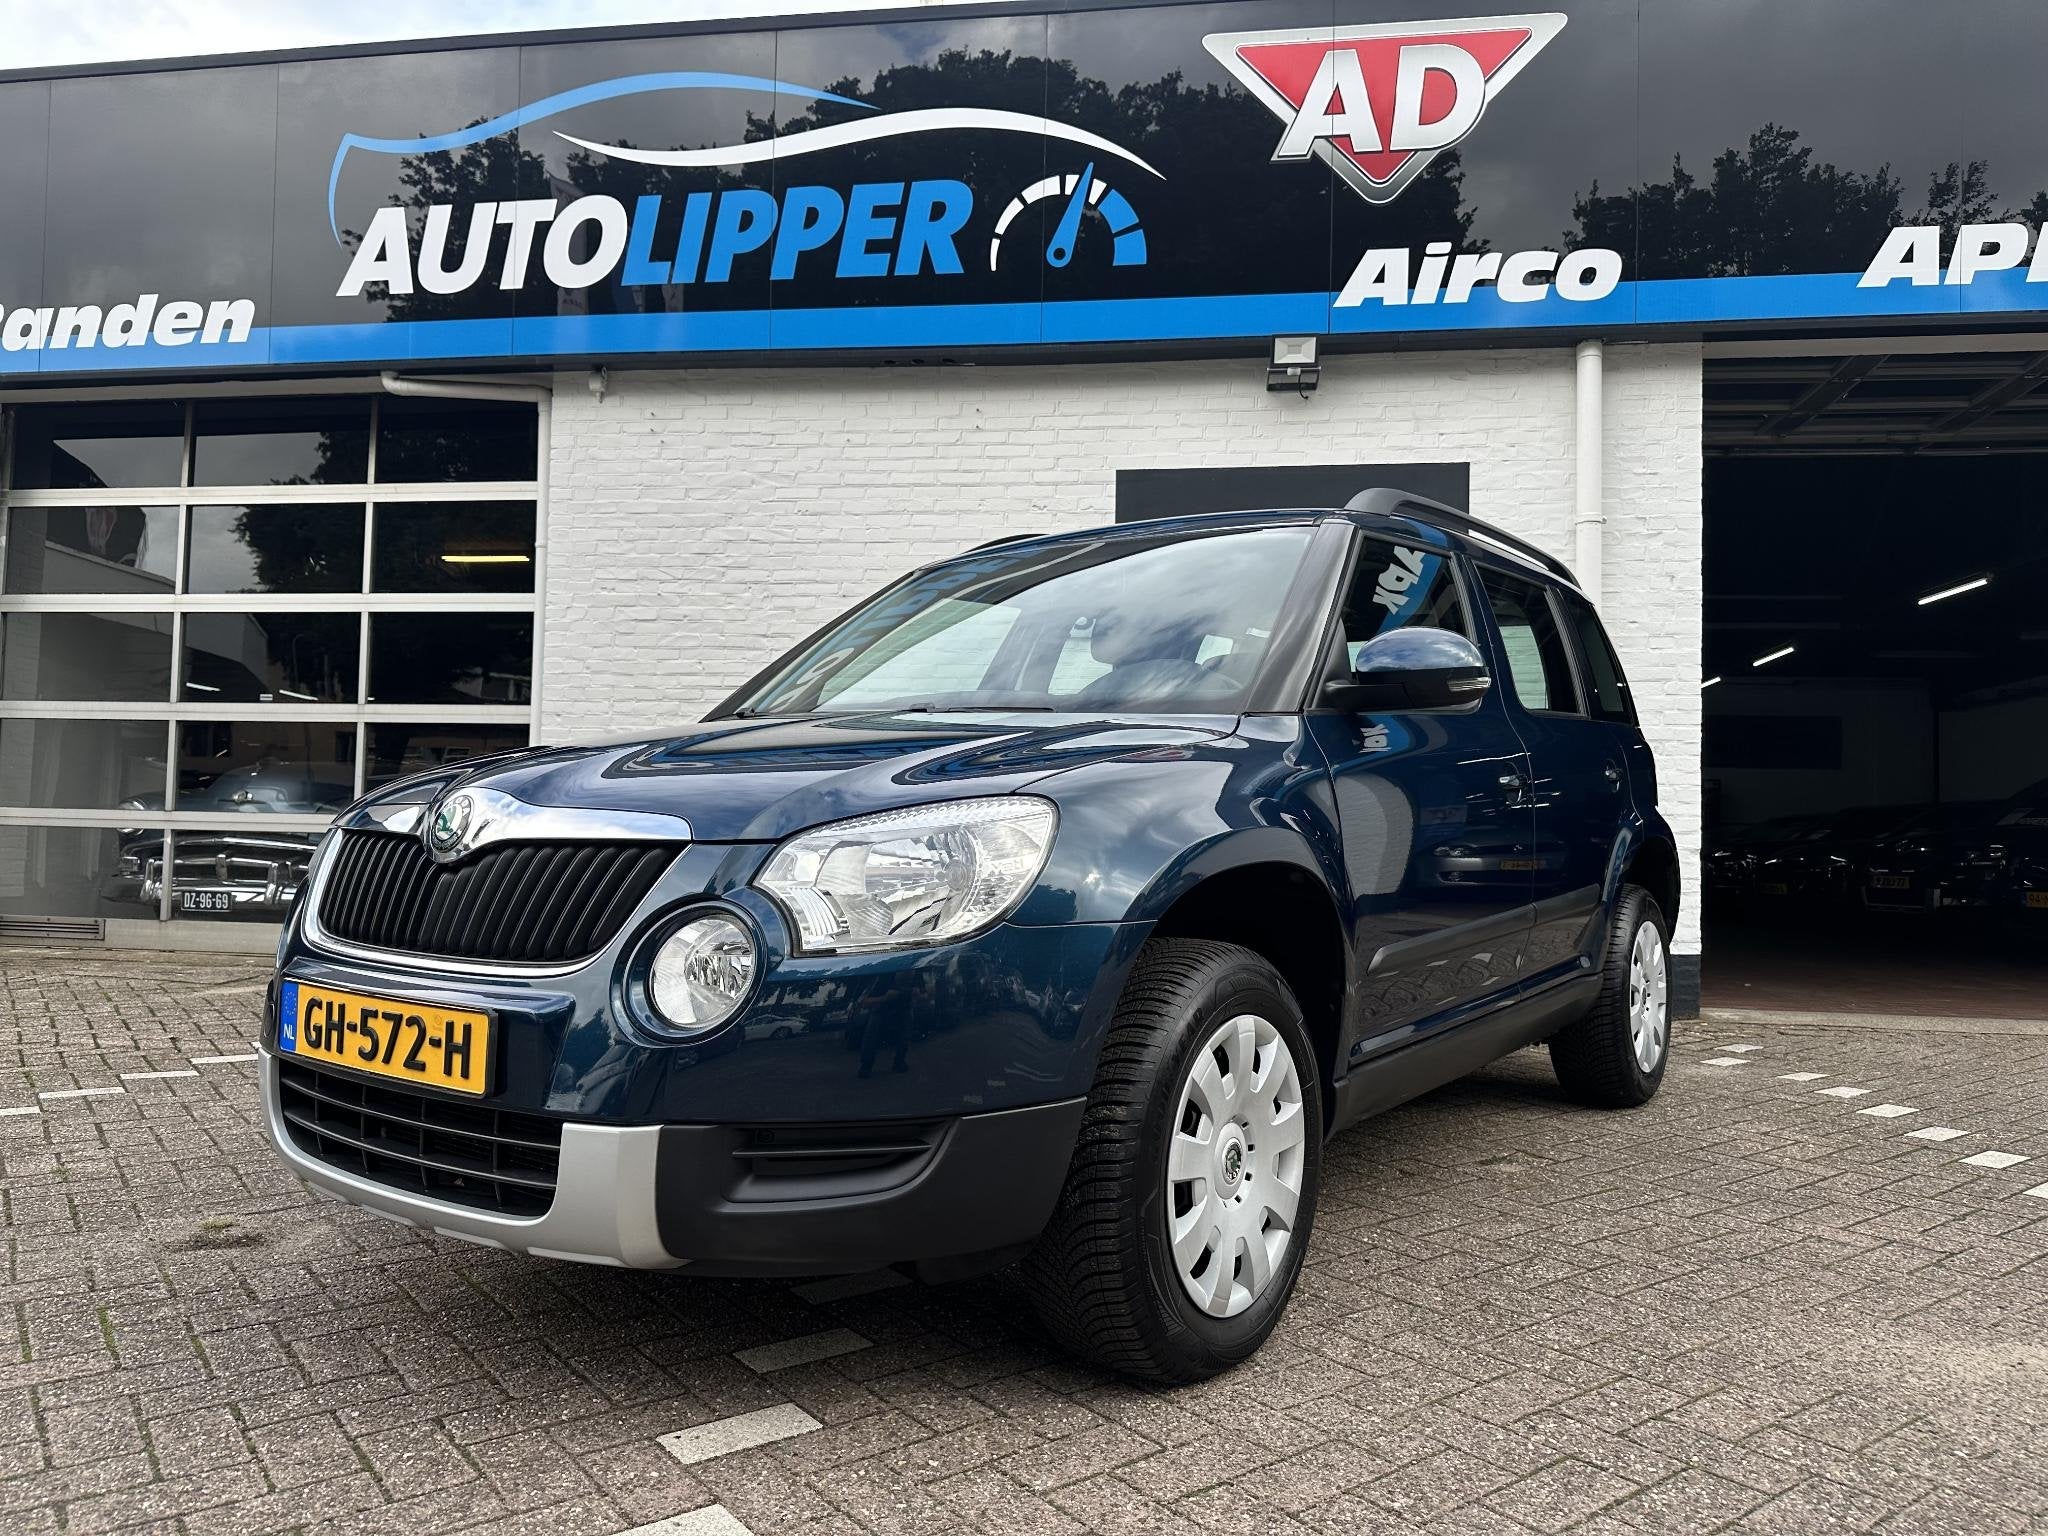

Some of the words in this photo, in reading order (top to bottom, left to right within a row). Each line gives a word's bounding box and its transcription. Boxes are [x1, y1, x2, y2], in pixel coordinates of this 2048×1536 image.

[1277, 45, 1486, 157] AD
[336, 180, 974, 297] AUTOLIPPER
[1333, 242, 1622, 308] Airco
[0, 294, 255, 352] anden
[184, 892, 229, 909] DZ-96-69
[283, 1023, 295, 1040] NL
[304, 996, 472, 1079] GH-572-H
